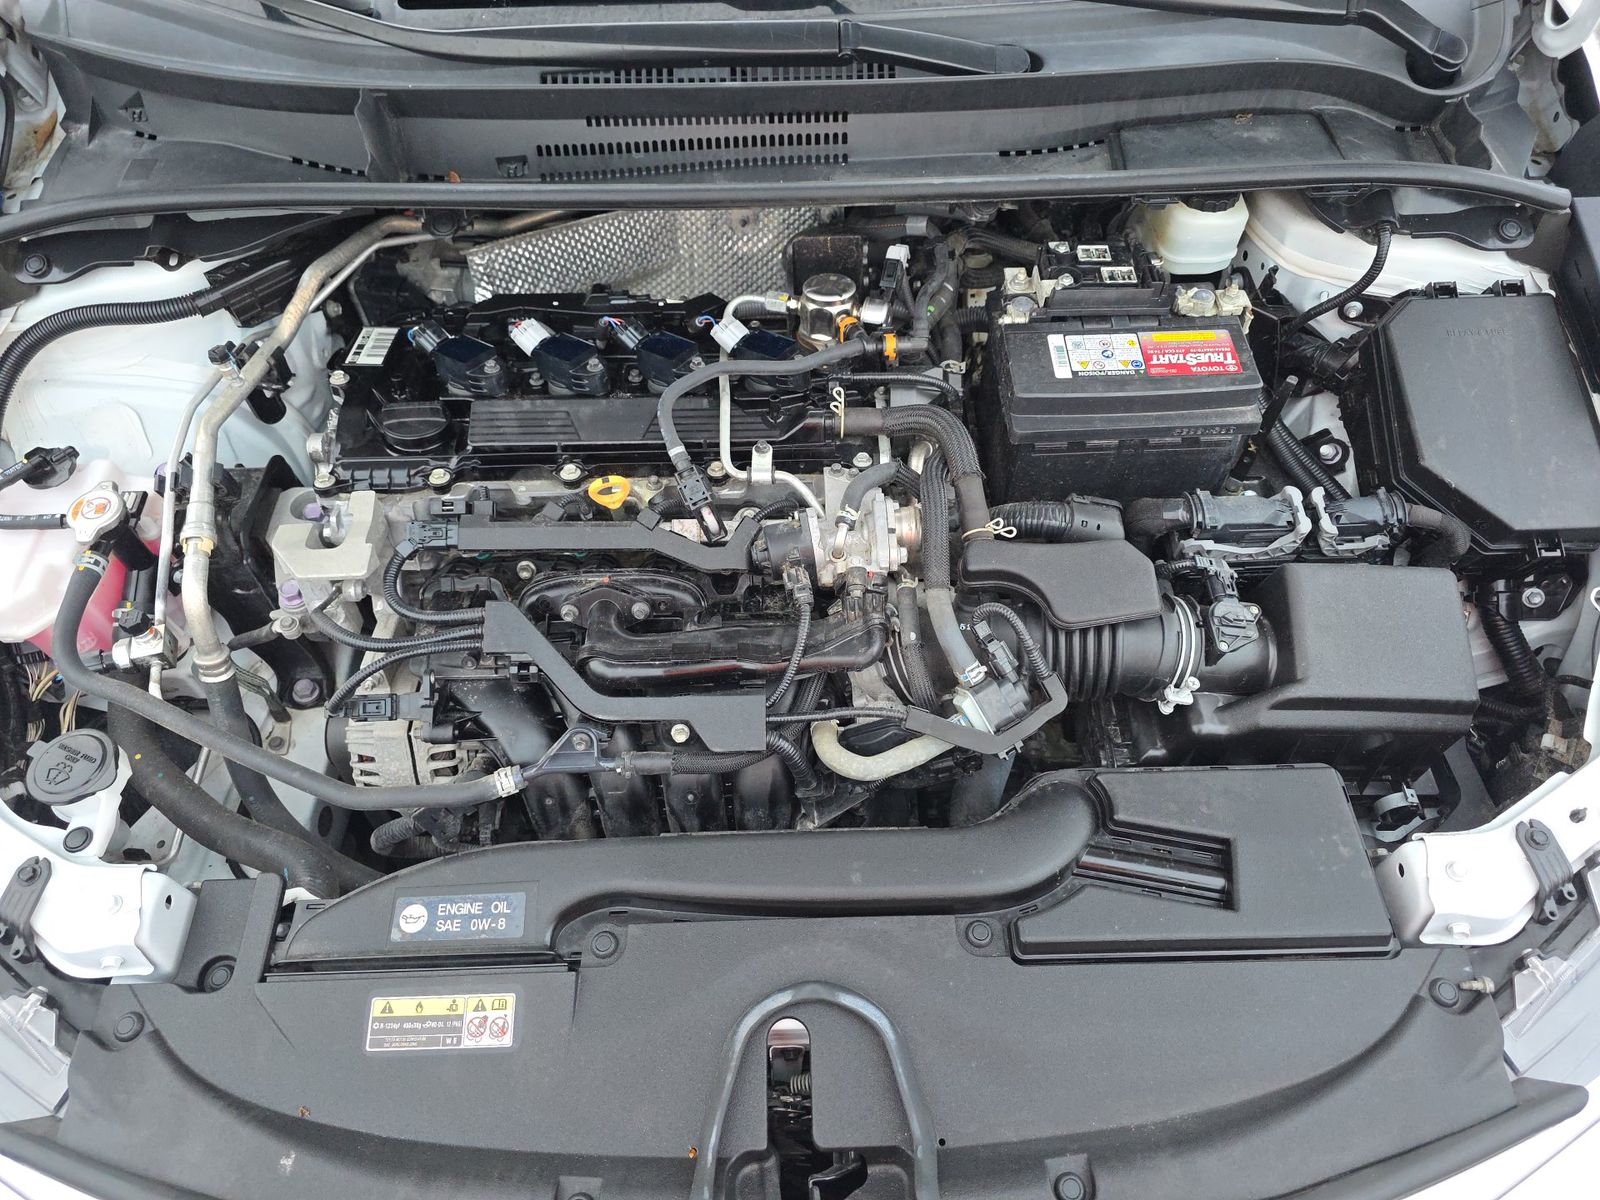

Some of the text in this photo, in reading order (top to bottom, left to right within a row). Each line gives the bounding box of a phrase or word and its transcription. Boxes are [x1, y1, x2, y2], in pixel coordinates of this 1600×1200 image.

[1078, 369, 1136, 377] DANGER/POISON
[437, 901, 511, 915] ENGINE OIL
[436, 918, 506, 932] SAE 0W-8
